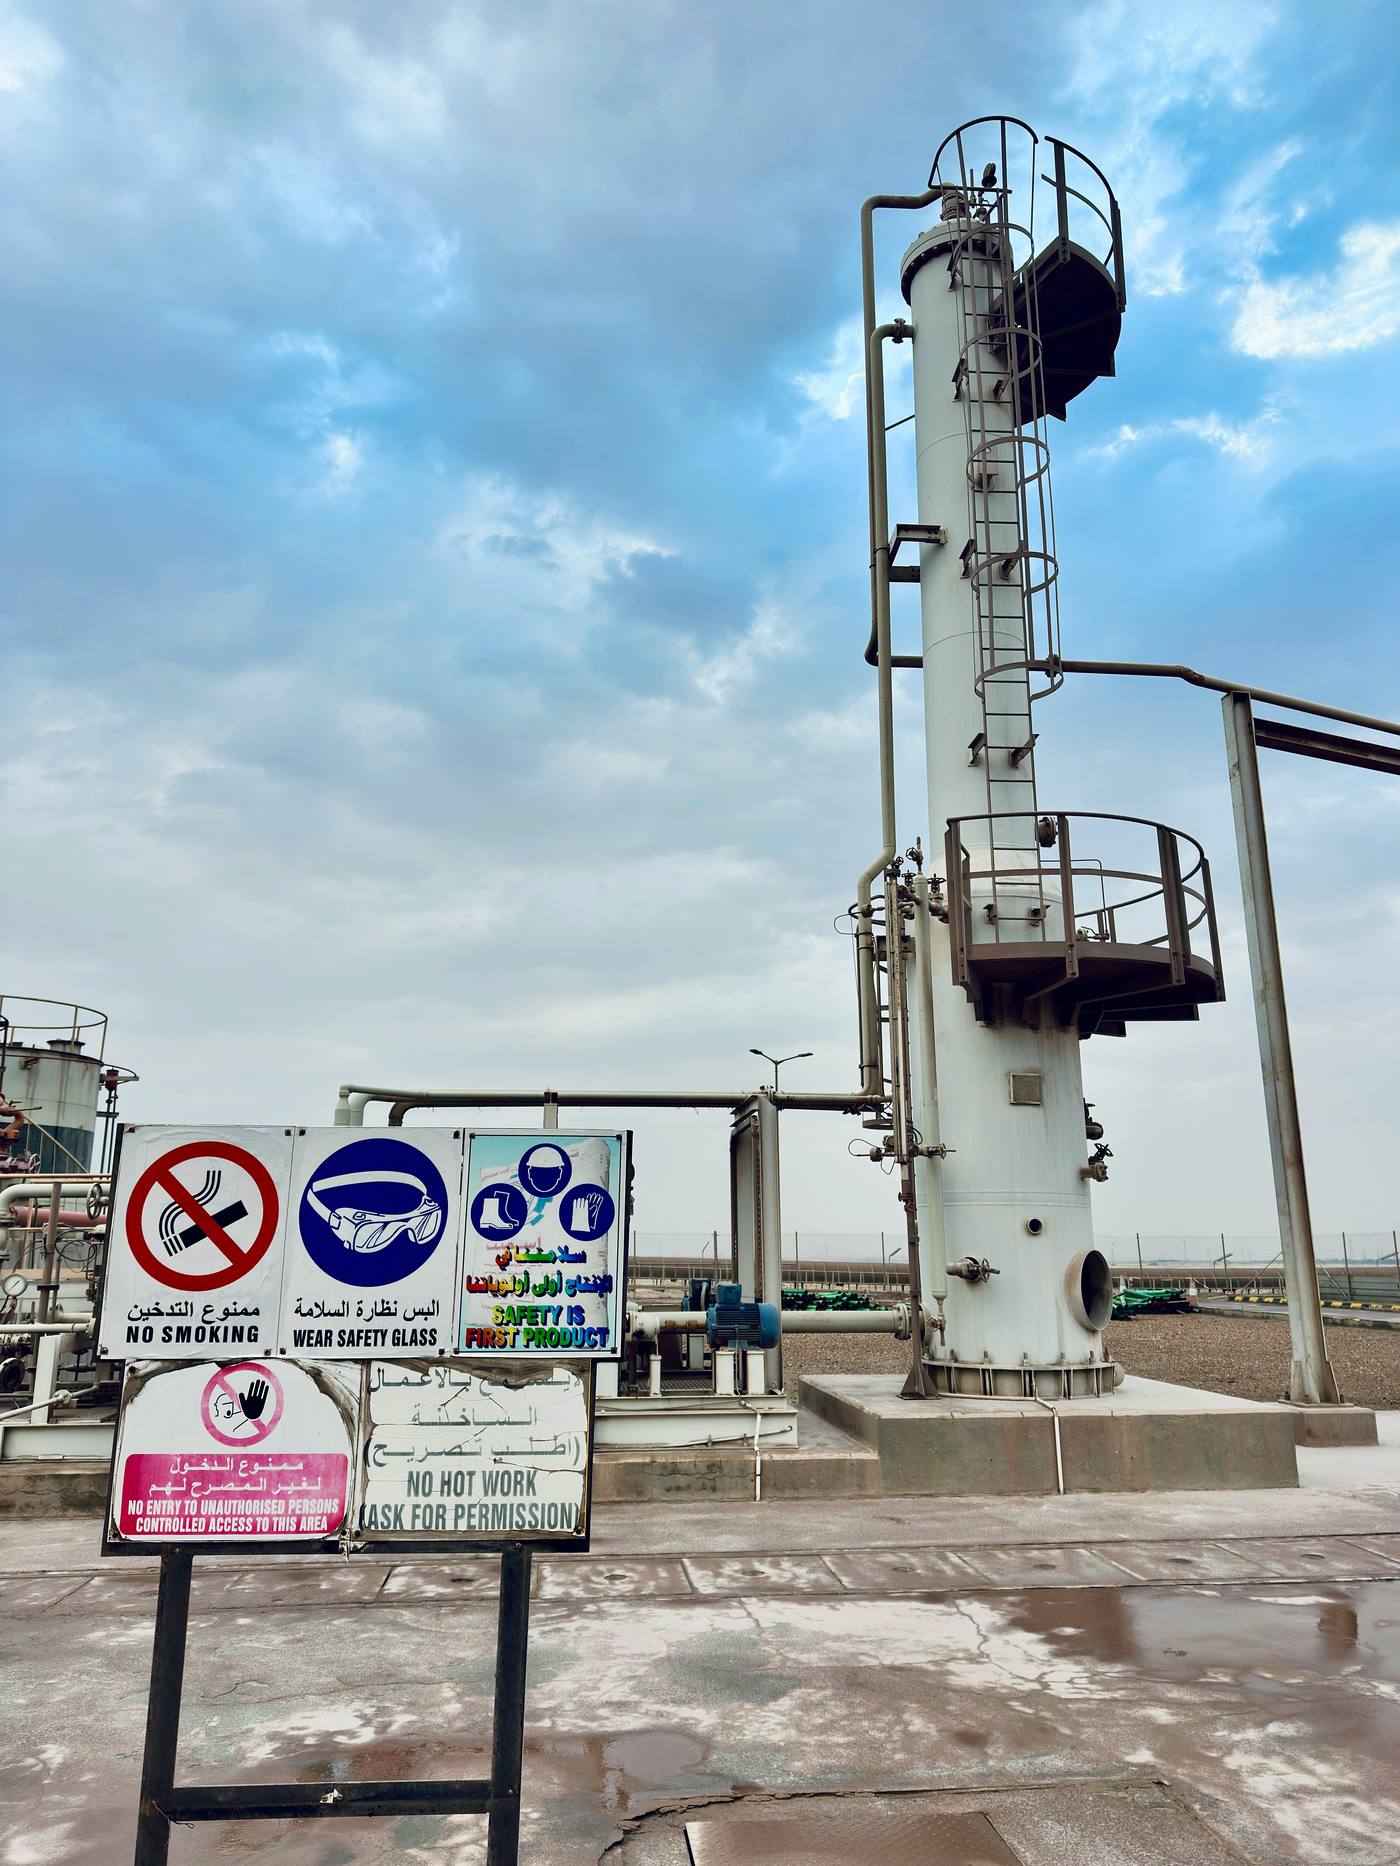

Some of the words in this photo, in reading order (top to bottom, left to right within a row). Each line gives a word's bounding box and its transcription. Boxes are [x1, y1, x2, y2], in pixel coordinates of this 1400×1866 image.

[495, 1245, 512, 1271] في
[513, 1245, 587, 1264] سلامتنا
[466, 1269, 530, 1298] أولوياتنا
[531, 1269, 563, 1297] أولى
[127, 1299, 194, 1322] التدخين
[201, 1300, 260, 1324] ممنوع
[293, 1298, 350, 1319] السلامة
[356, 1300, 398, 1322] نظارة
[402, 1300, 440, 1321] البس
[491, 1305, 563, 1326] SAFETY
[567, 1304, 586, 1326] IS
[126, 1325, 154, 1343] NO
[161, 1325, 259, 1343] SMOKING
[293, 1329, 335, 1347] WEAR
[337, 1328, 388, 1347] SAFETY
[391, 1328, 437, 1347] GLASS
[465, 1327, 519, 1348] FIRST
[522, 1327, 610, 1348] PRODUCT
[169, 1455, 234, 1474] الدخول
[238, 1457, 304, 1477] ممنوع
[149, 1477, 186, 1498] لهم
[190, 1477, 267, 1497] المصرح
[271, 1476, 321, 1495] لغير
[407, 1470, 434, 1498] NO
[439, 1470, 476, 1498] HOT
[482, 1470, 537, 1498] WORK
[128, 1500, 143, 1516] NO
[146, 1500, 181, 1516] ENTRY
[184, 1500, 198, 1516] TO
[200, 1499, 285, 1515] UNAUTHORISED
[287, 1498, 339, 1515] PERSONS
[411, 1503, 447, 1530] FOR
[454, 1502, 579, 1530] PERMISSION)
[135, 1517, 206, 1533] CONTROLLED
[208, 1516, 253, 1532] ACCESS
[255, 1516, 269, 1532] TO
[272, 1516, 295, 1532] THIS
[299, 1515, 328, 1531] AREA
